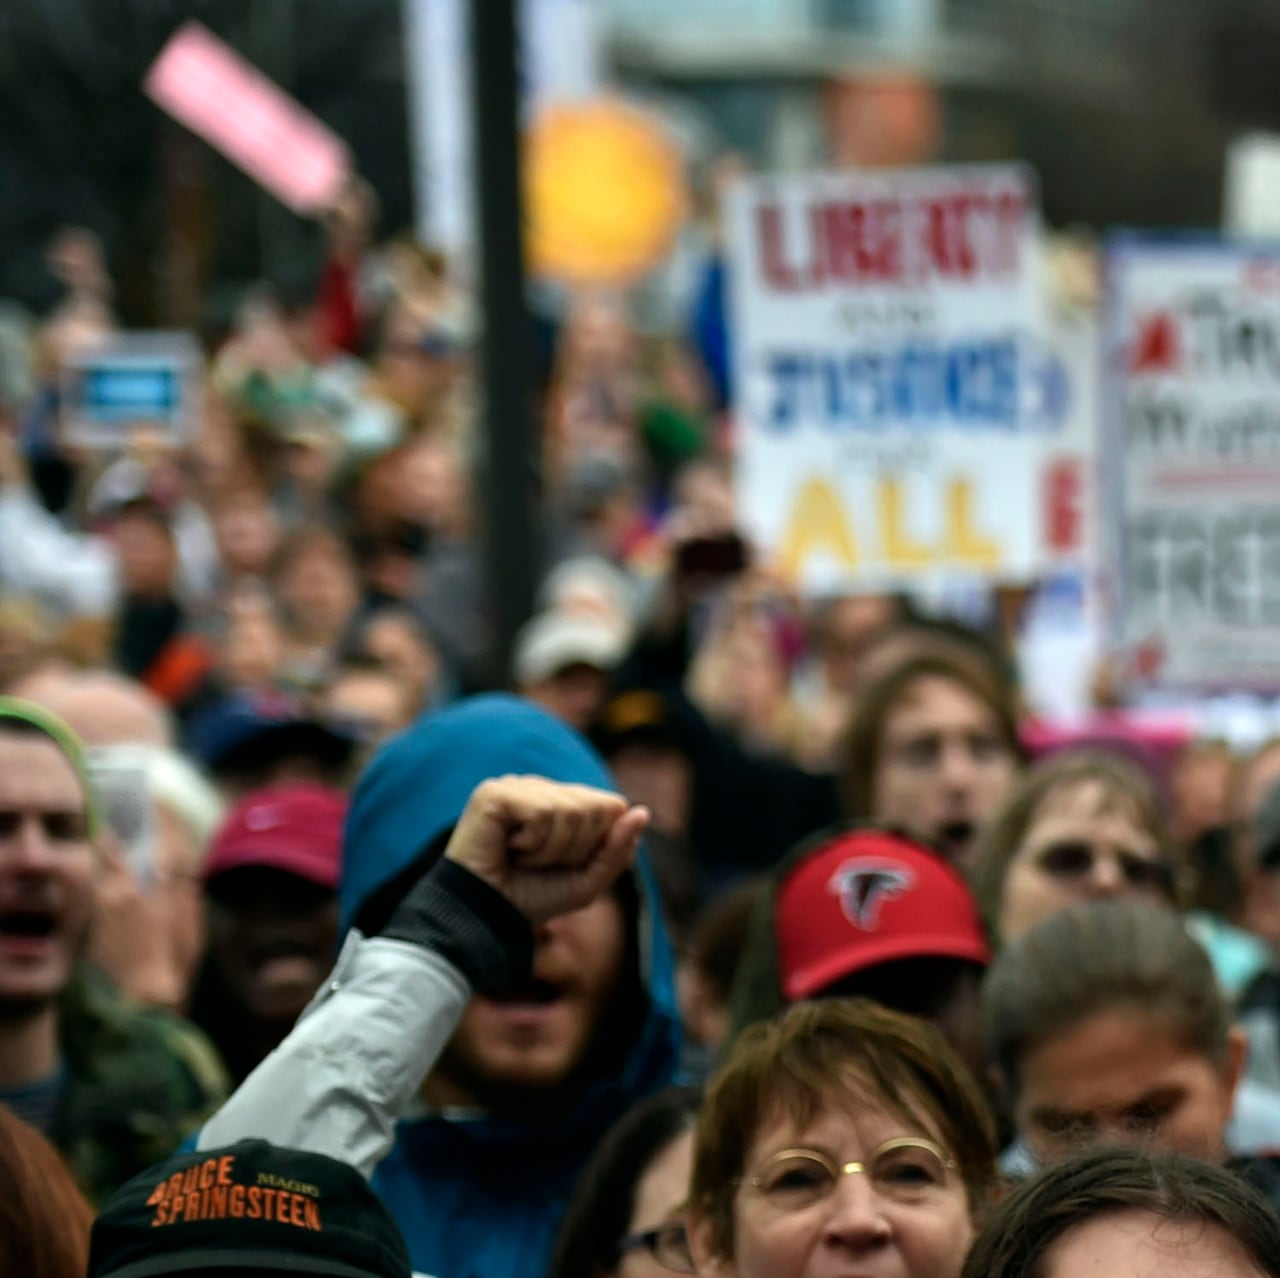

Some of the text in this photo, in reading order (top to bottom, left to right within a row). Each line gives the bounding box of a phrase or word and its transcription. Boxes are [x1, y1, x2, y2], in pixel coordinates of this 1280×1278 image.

[780, 472, 1002, 575] ALL
[146, 1155, 236, 1206] BRUCE
[151, 1184, 322, 1231] SPRINGSTEEN
